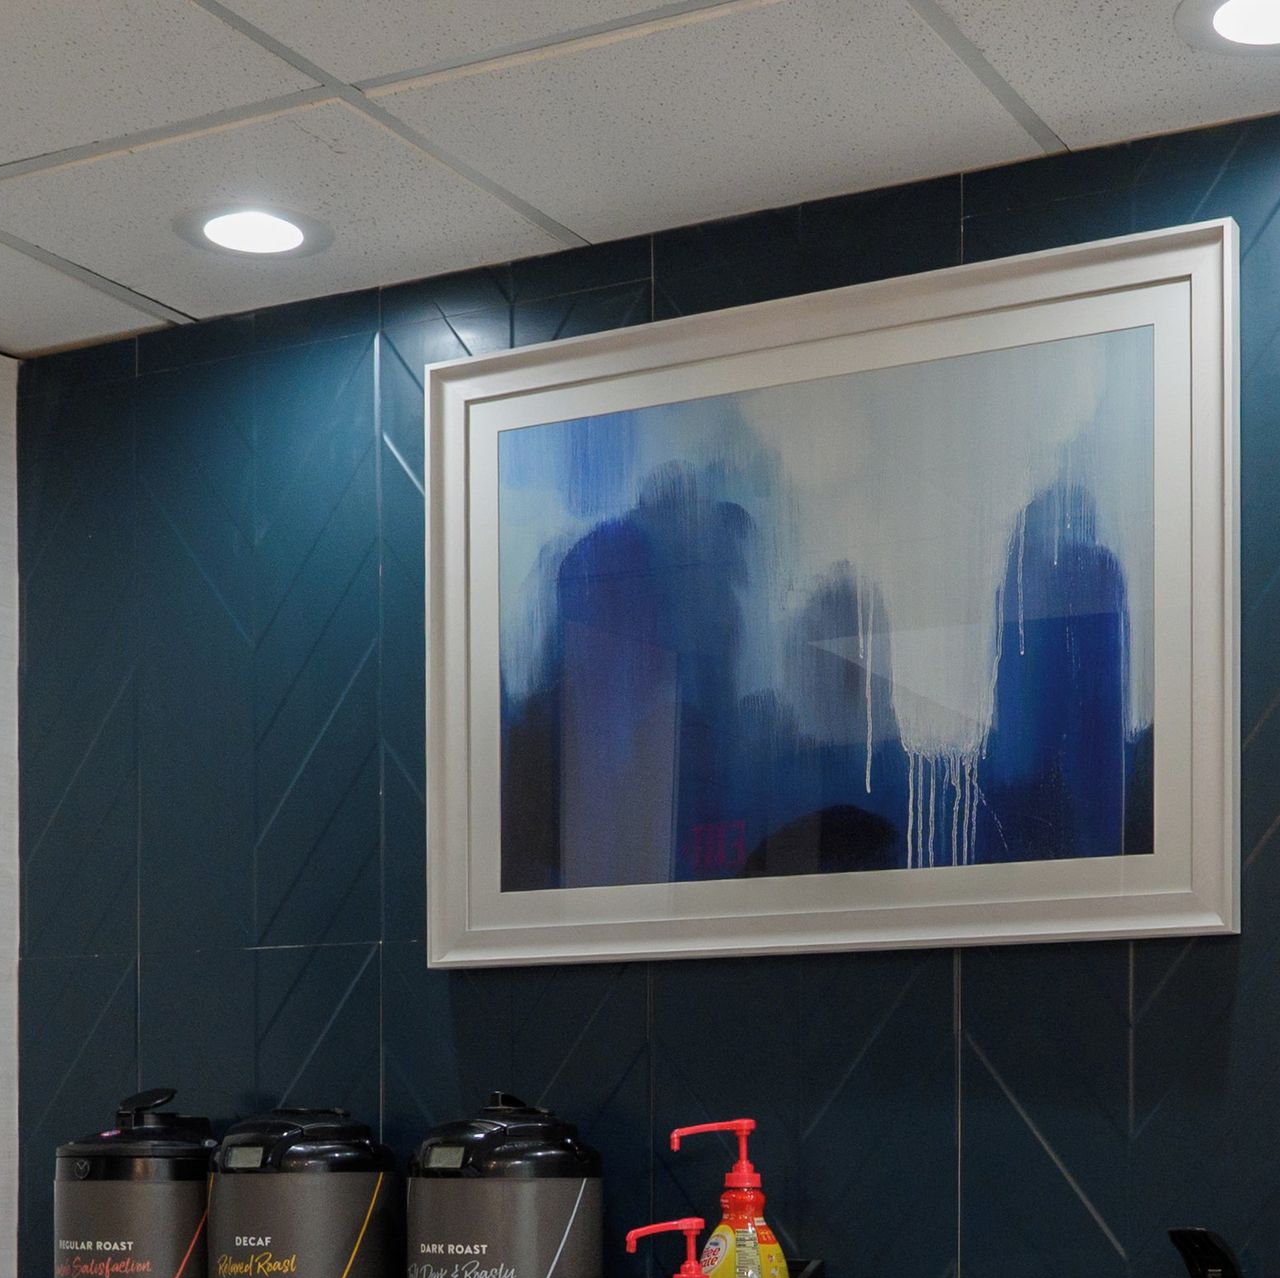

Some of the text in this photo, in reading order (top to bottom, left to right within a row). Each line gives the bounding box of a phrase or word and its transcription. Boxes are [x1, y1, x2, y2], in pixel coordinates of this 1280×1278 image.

[96, 1241, 133, 1250] ROAST
[235, 1237, 272, 1246] DECAF
[420, 1244, 488, 1254] DARK ROAST
[255, 1252, 297, 1277] Roast
